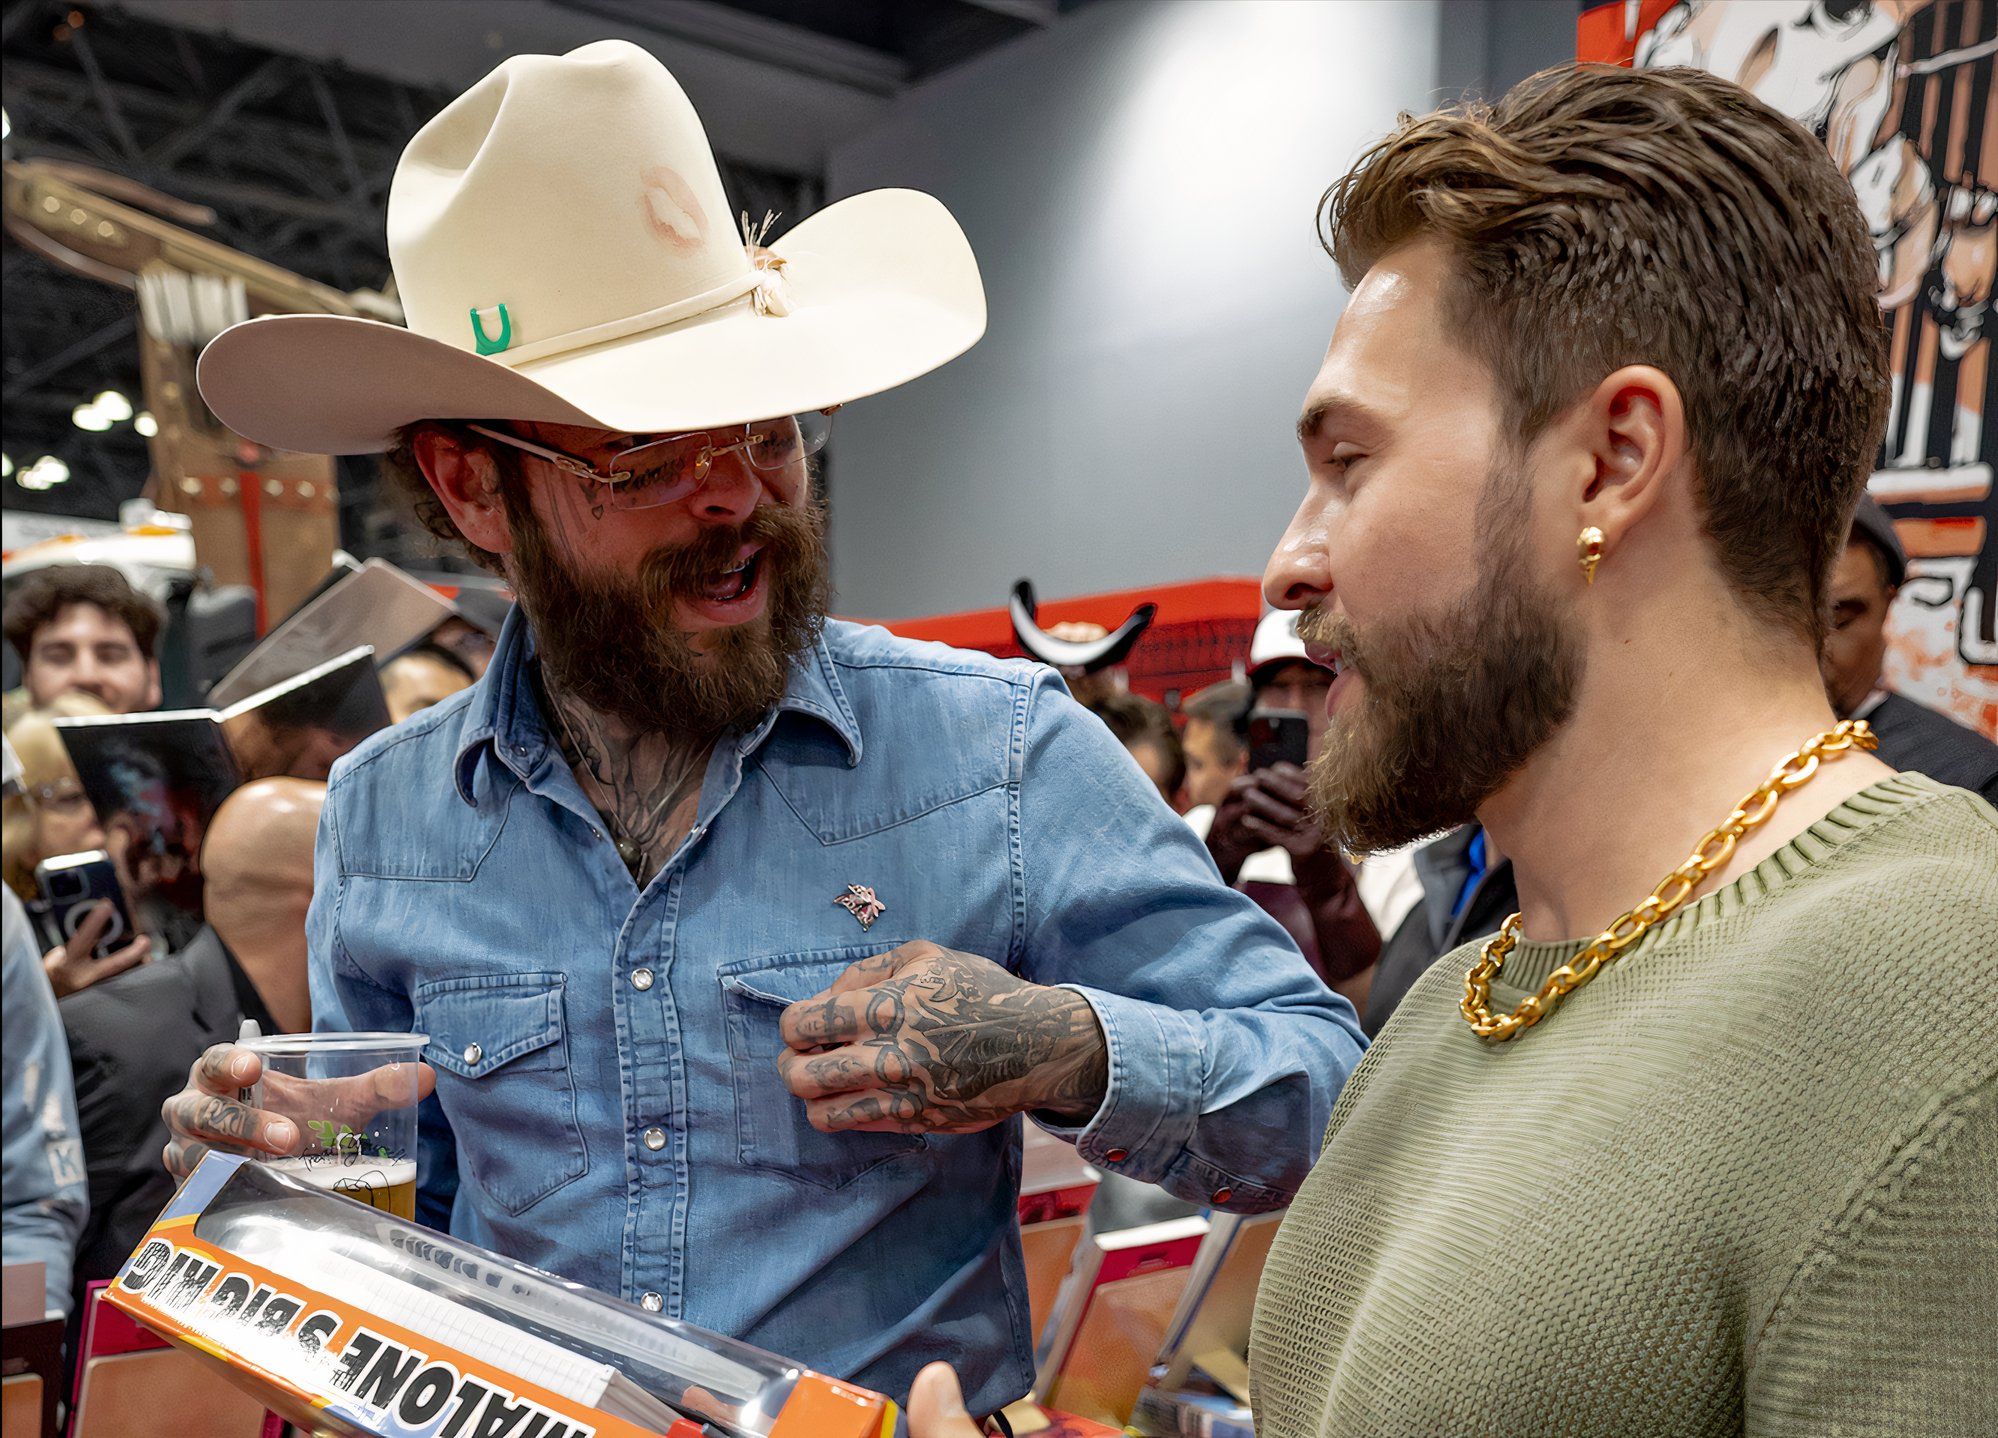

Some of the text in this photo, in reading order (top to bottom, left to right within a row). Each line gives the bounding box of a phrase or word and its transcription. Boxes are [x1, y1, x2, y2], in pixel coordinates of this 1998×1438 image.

[122, 1241, 588, 1438] ALONES BIG RIG
